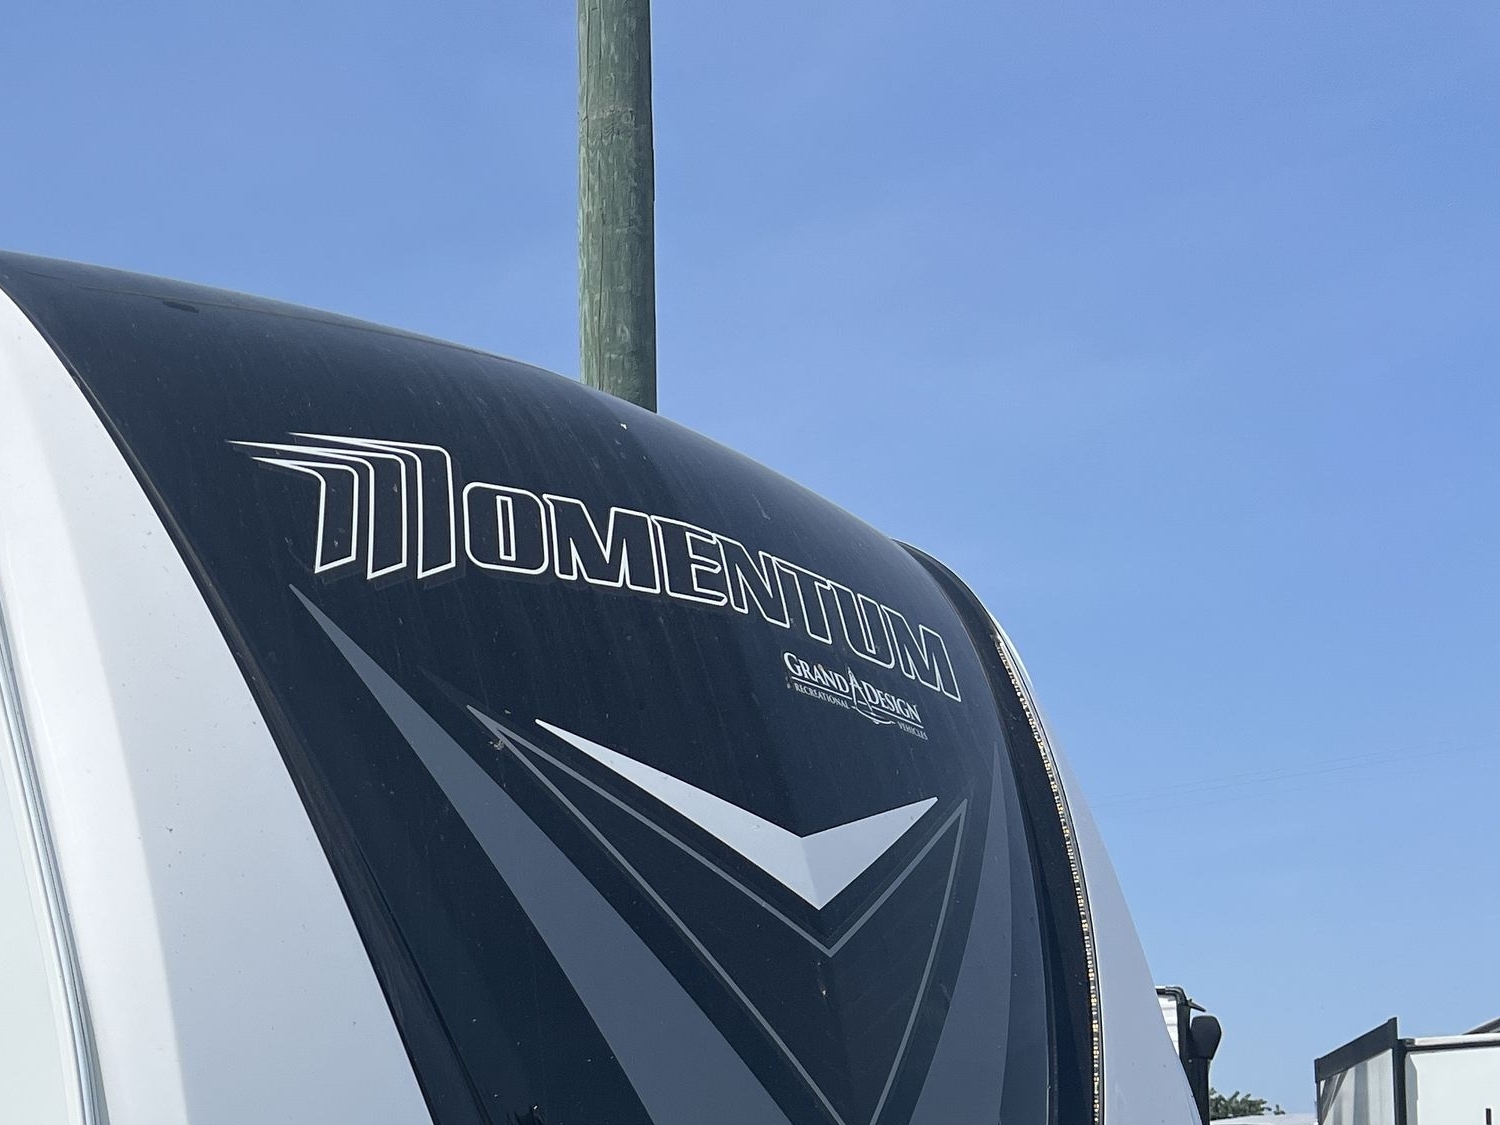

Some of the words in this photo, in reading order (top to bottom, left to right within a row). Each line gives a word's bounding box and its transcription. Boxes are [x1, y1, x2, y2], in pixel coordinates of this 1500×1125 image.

[226, 431, 962, 703] MOMENTUM
[783, 651, 850, 694] GRAND
[861, 679, 923, 724] DESIGN
[794, 682, 851, 710] RECREATIONAL
[897, 720, 929, 741] VEHICLES
